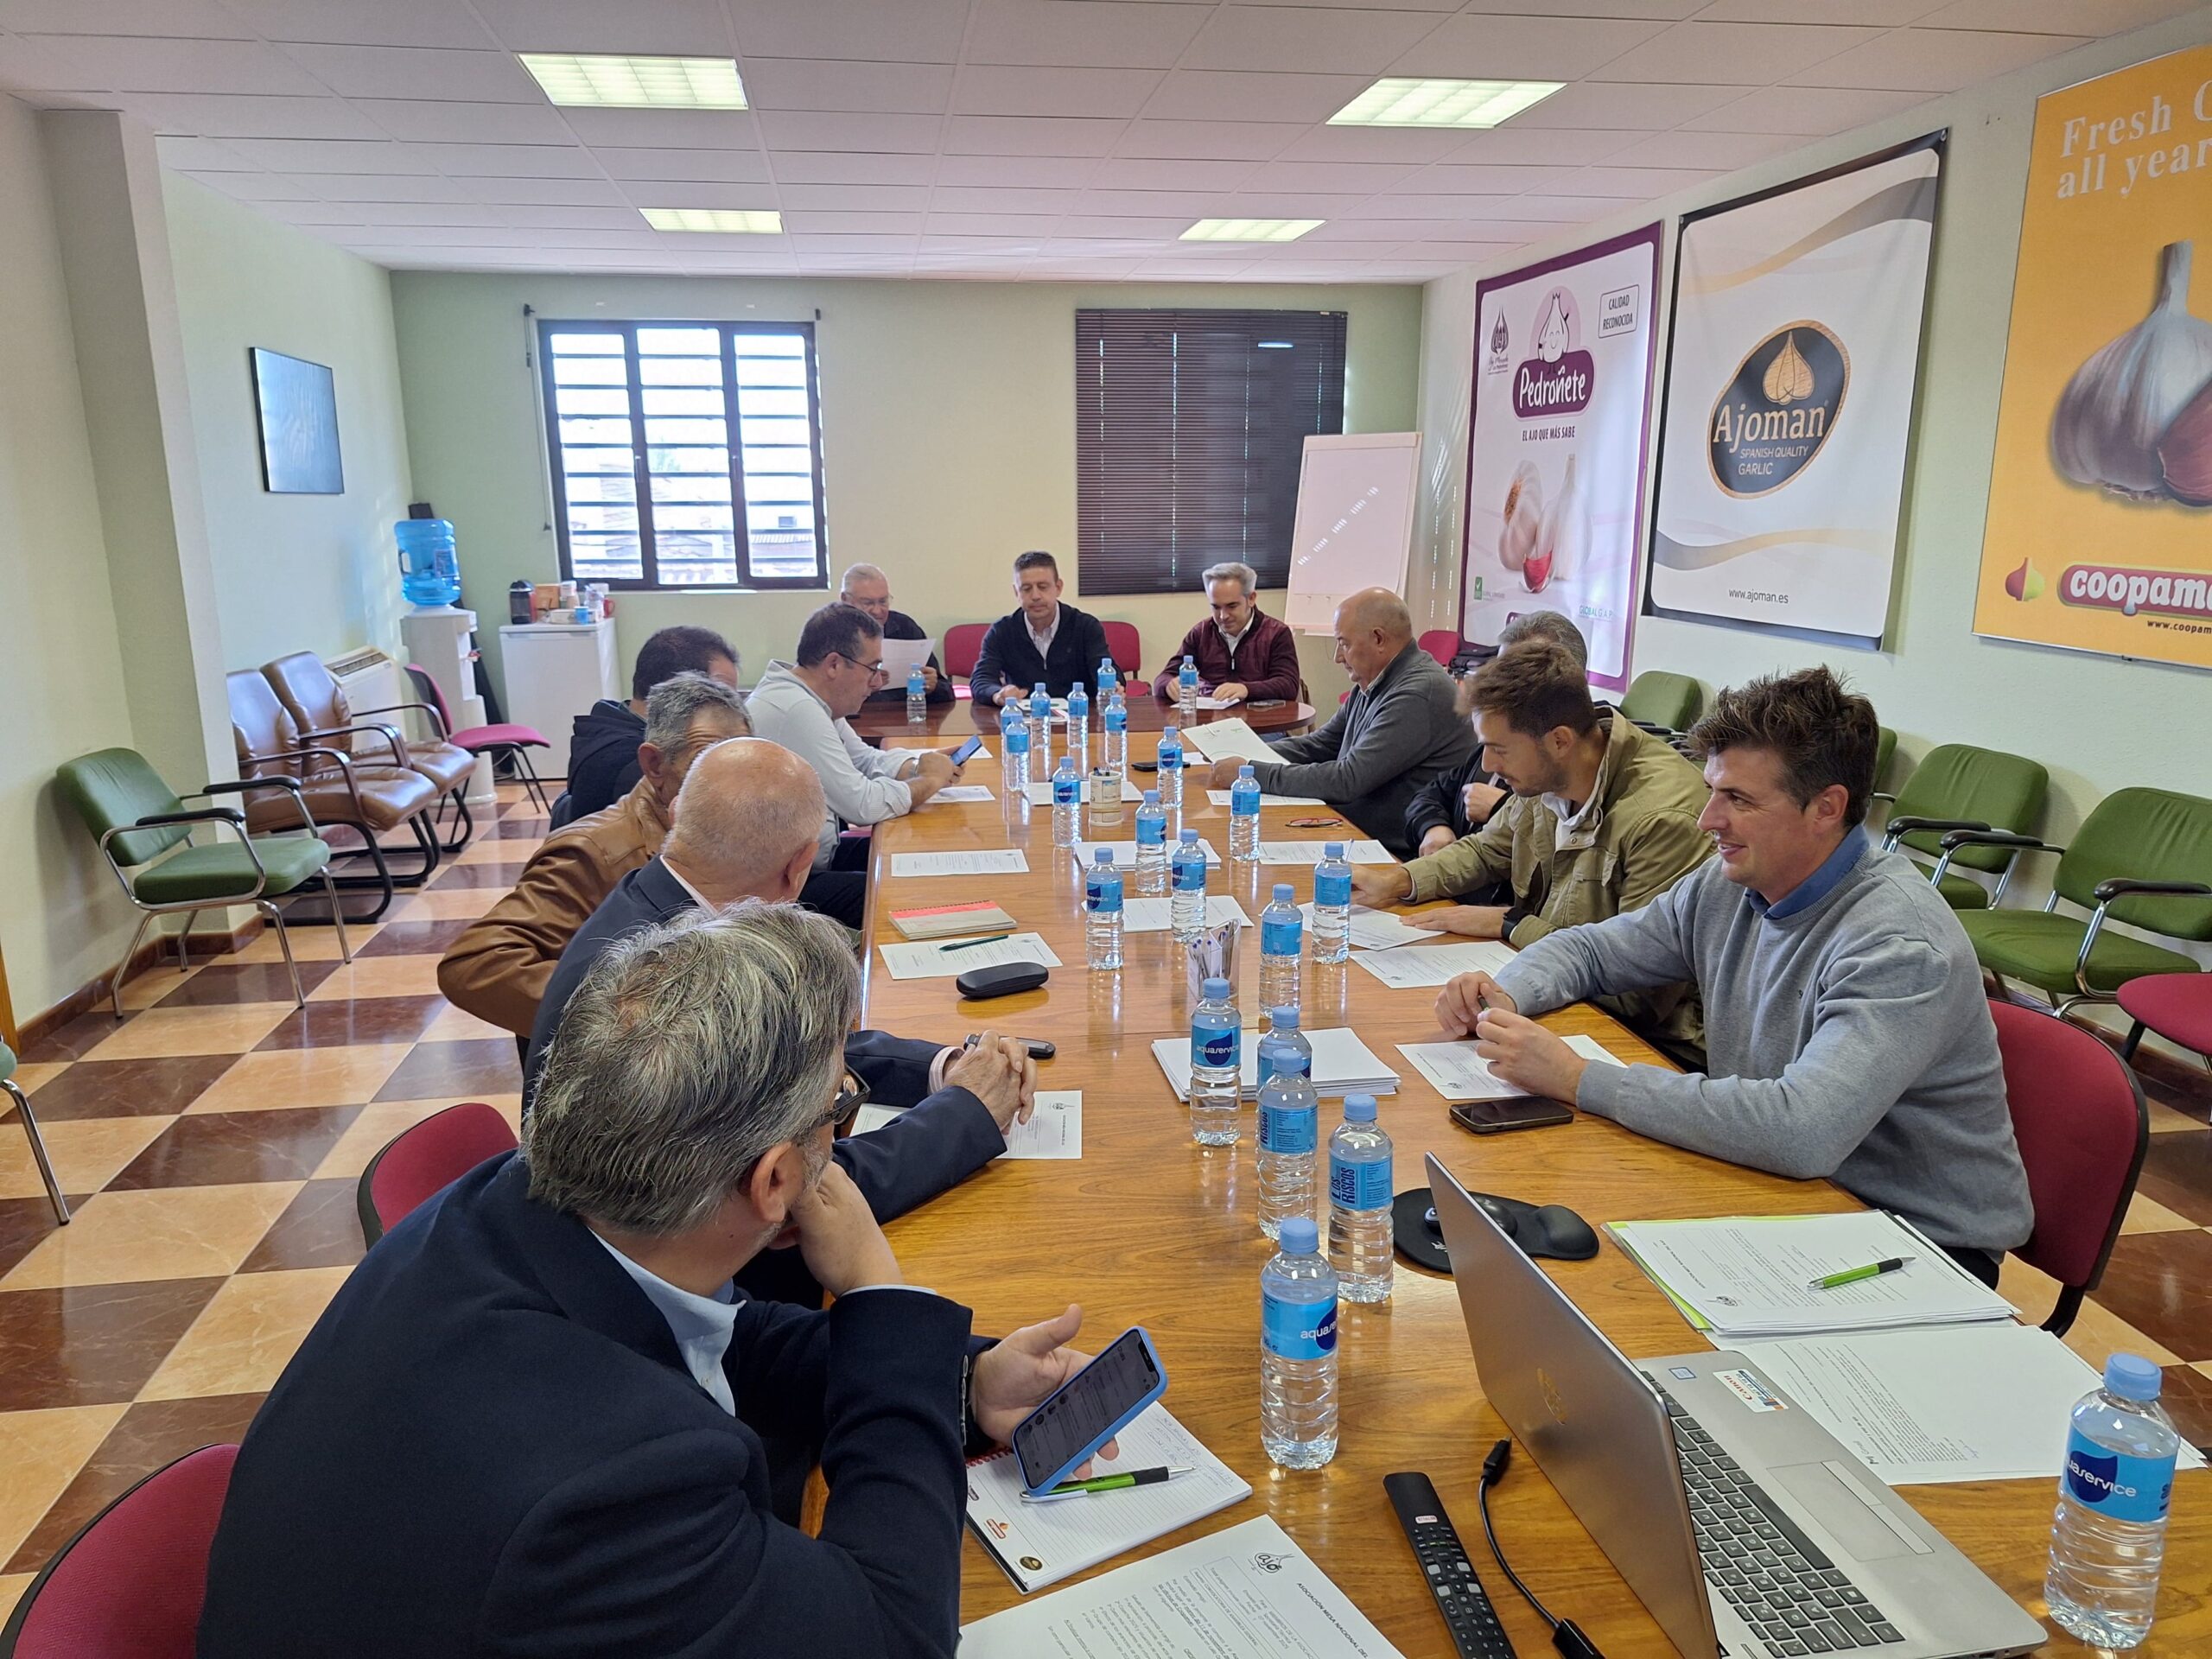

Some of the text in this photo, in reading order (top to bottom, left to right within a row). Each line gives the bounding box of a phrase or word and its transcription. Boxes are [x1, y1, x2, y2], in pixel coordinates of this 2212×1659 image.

[2060, 95, 2171, 158] Fresh
[2057, 138, 2212, 199] all year
[1608, 294, 1630, 310] CALIDAD
[1603, 312, 1633, 330] RECONOCIDA
[1518, 365, 1586, 409] Pedroñete
[1522, 425, 1576, 442] EL AJO QUE MÁS SABE
[1713, 403, 1826, 454] Ajoman
[1739, 446, 1809, 459] SPANISH QUALITY
[1738, 462, 1774, 475] GARLIC
[1728, 588, 1789, 604] www.ajoman.es
[2070, 570, 2212, 615] coopam
[1196, 1044, 1239, 1055] aquaservice
[1341, 1167, 1356, 1204] RISCOS
[1724, 1375, 1752, 1402] Canon
[1297, 1582, 1369, 1659] ASOCIACIÓN MESA NACIONAL DEL
